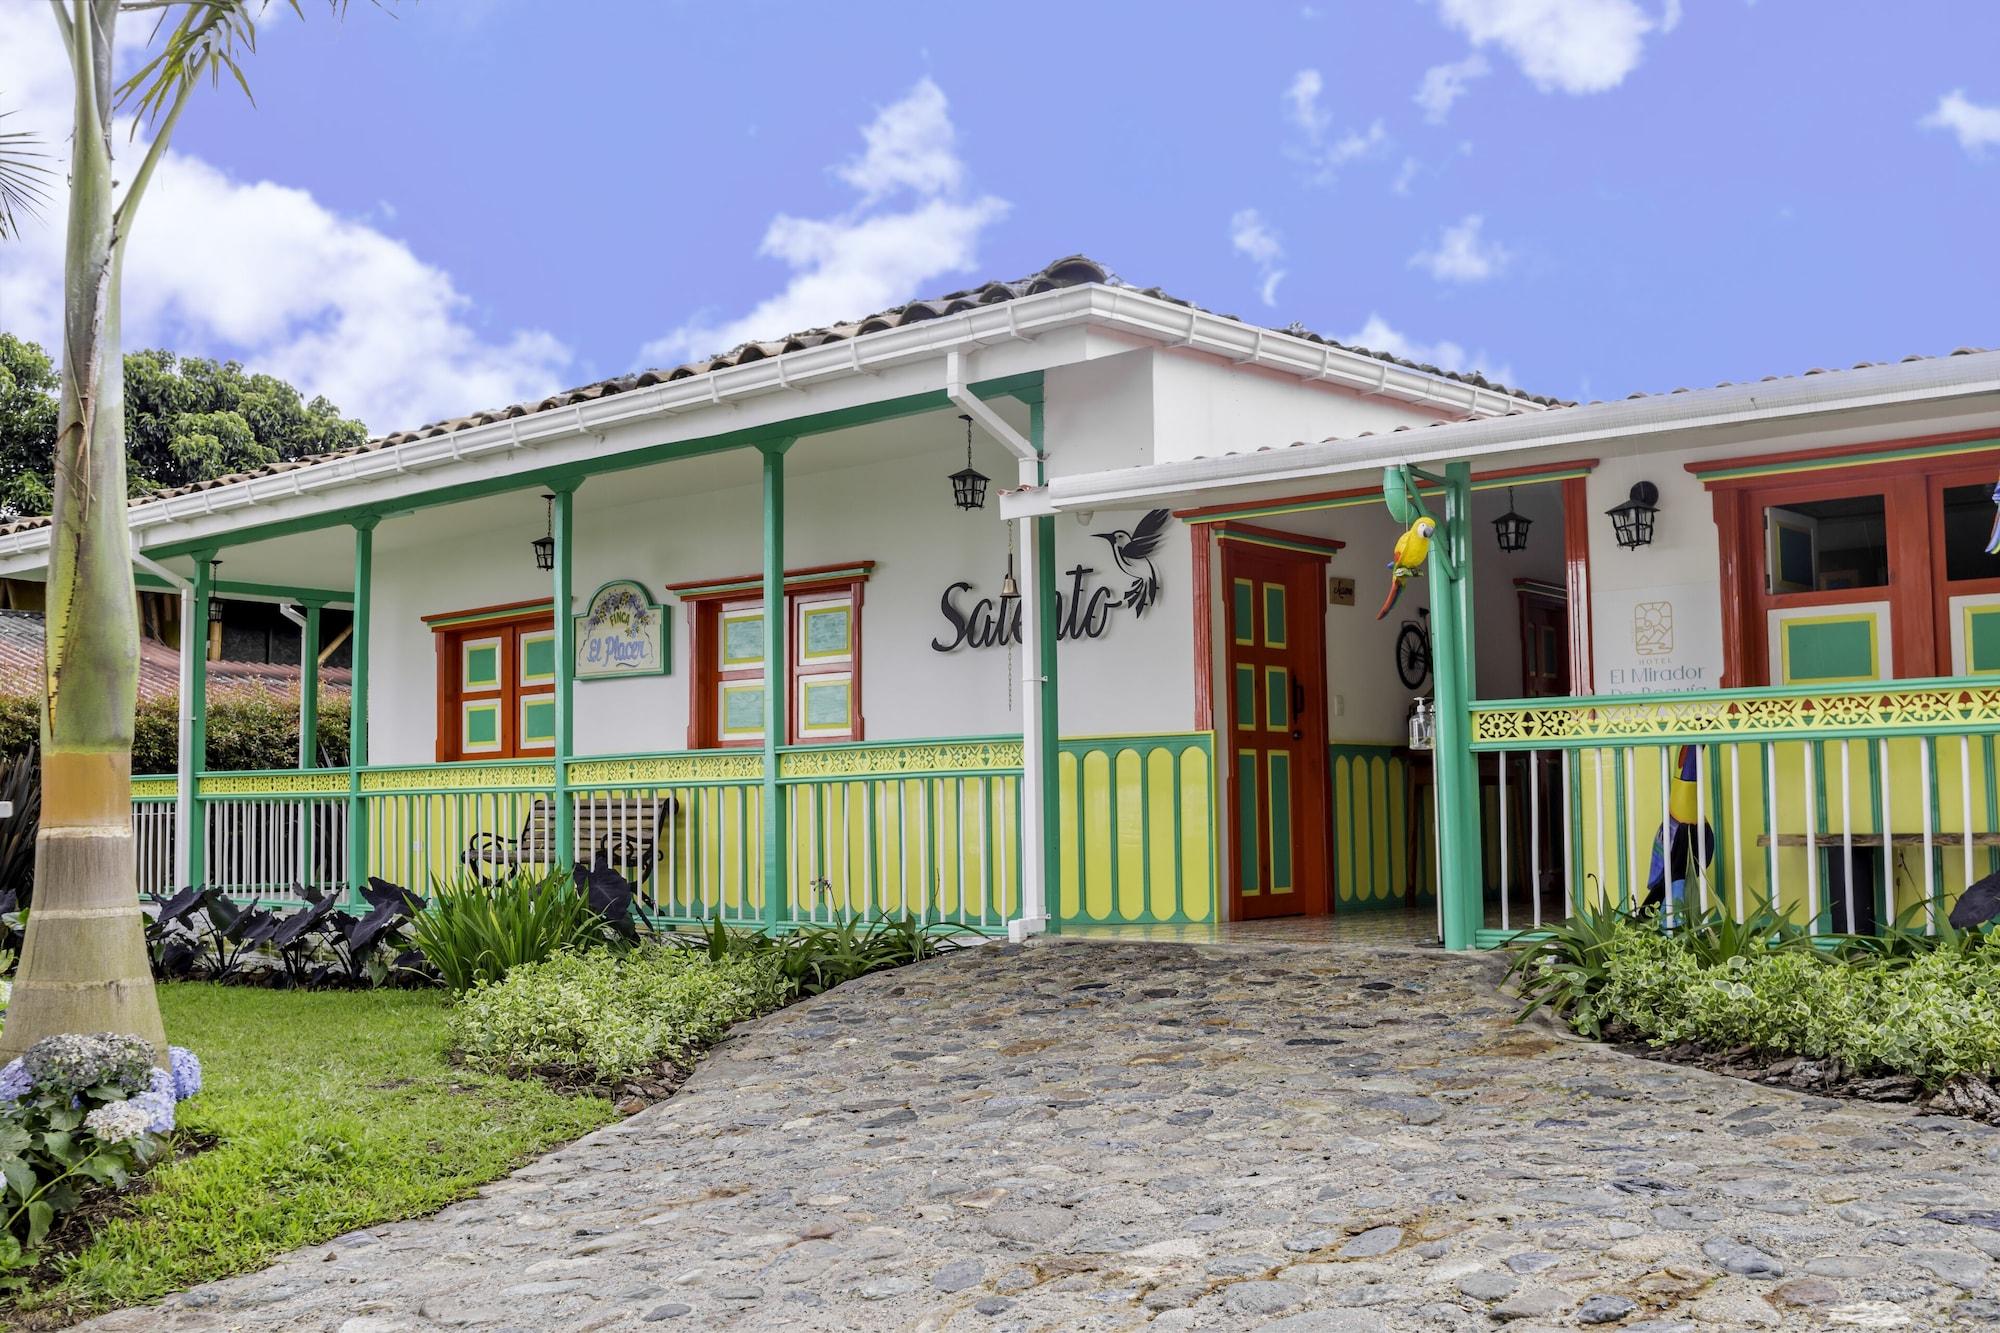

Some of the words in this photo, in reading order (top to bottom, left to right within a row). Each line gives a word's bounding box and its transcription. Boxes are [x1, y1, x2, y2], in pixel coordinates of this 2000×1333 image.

[609, 611, 630, 627] FINCA
[587, 638, 602, 662] El
[602, 635, 649, 667] Placer
[1610, 669, 1625, 684] El
[1631, 665, 1708, 683] Mirador
